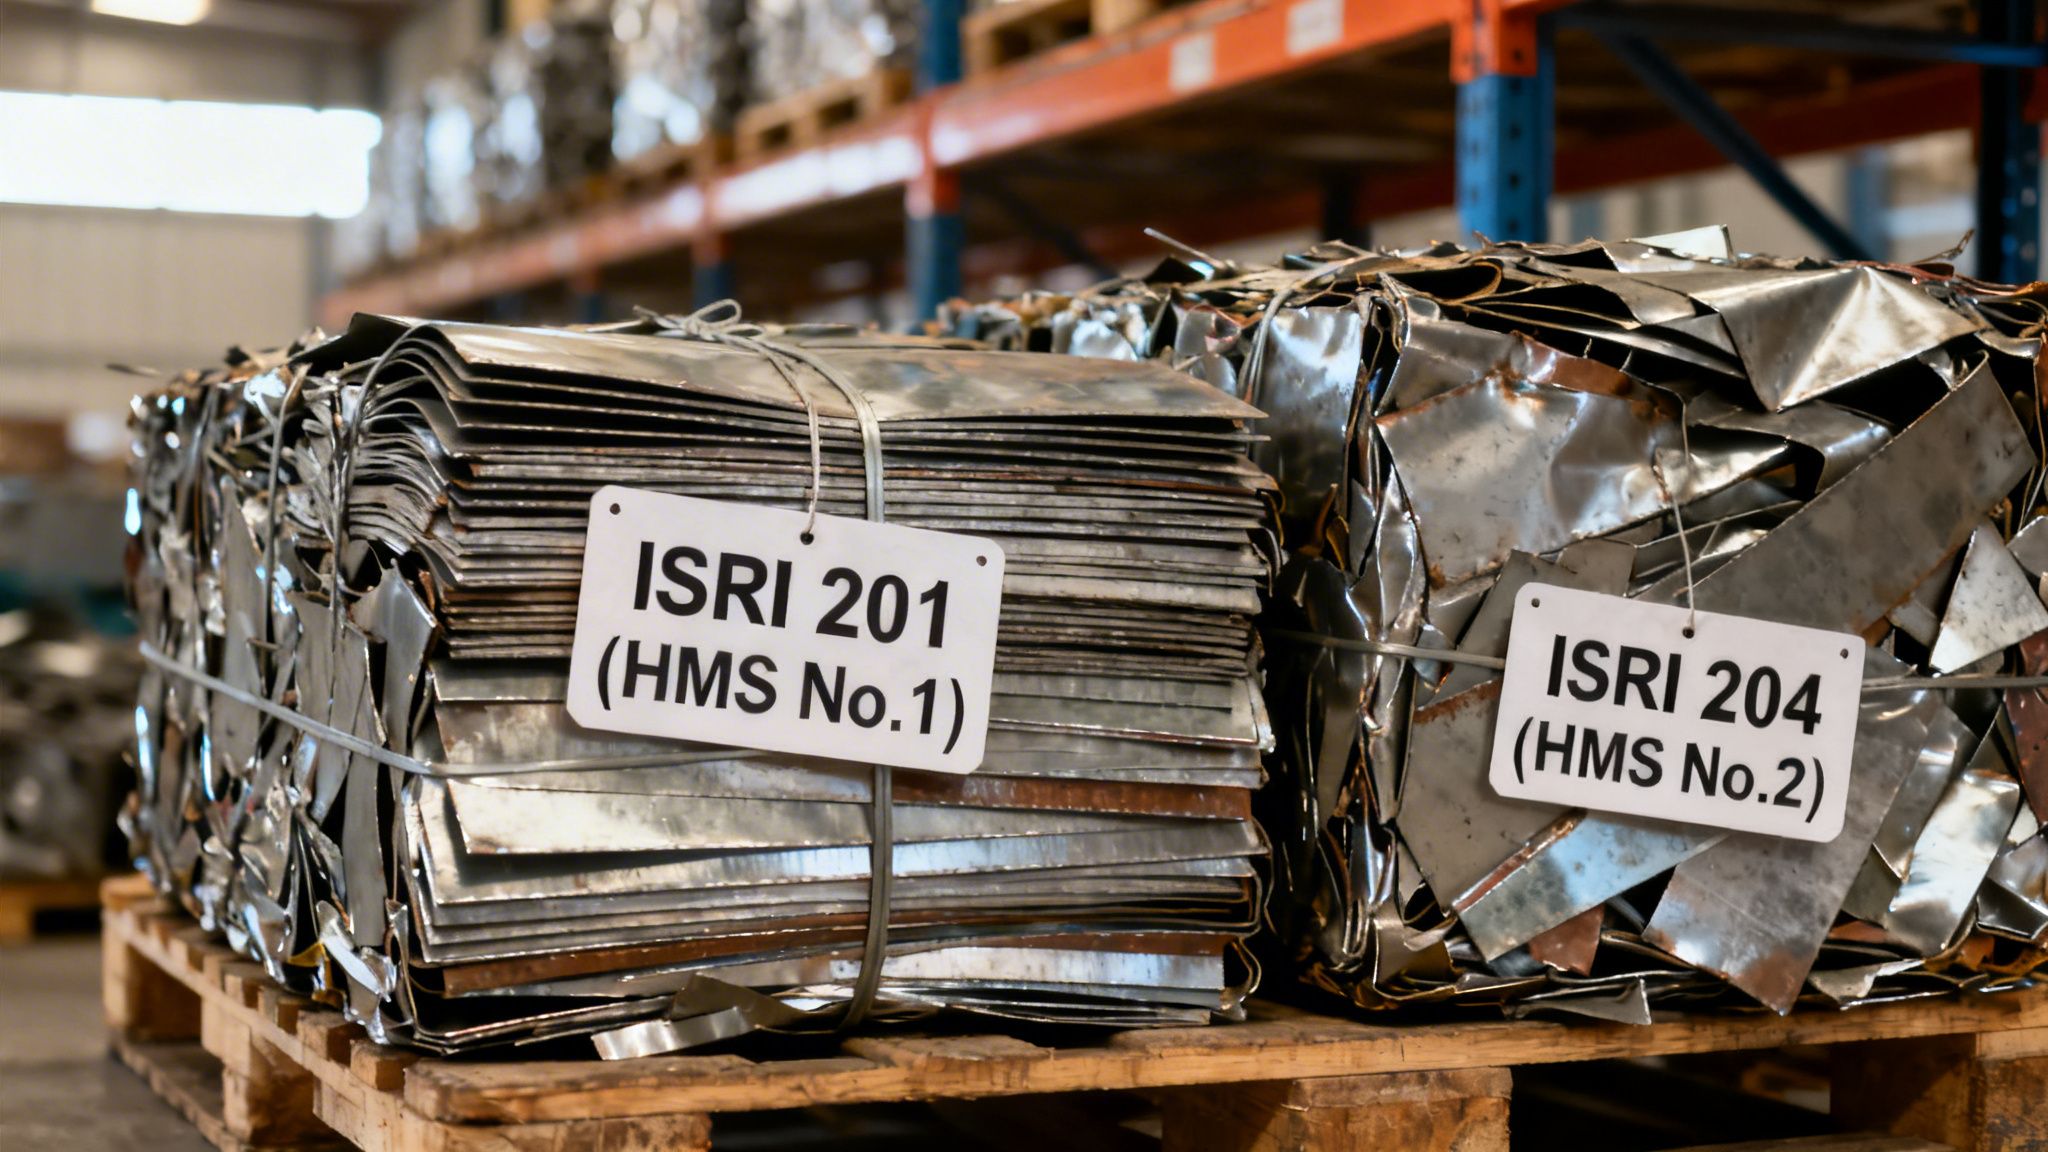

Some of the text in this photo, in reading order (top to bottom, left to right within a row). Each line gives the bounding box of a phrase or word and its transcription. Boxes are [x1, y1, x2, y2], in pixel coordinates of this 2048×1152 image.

[633, 540, 949, 649] ISRI 201
[597, 635, 965, 755] (HMS No.1)
[1546, 633, 1823, 736] ISRI 204
[1513, 716, 1825, 824] (HMS No.2)
